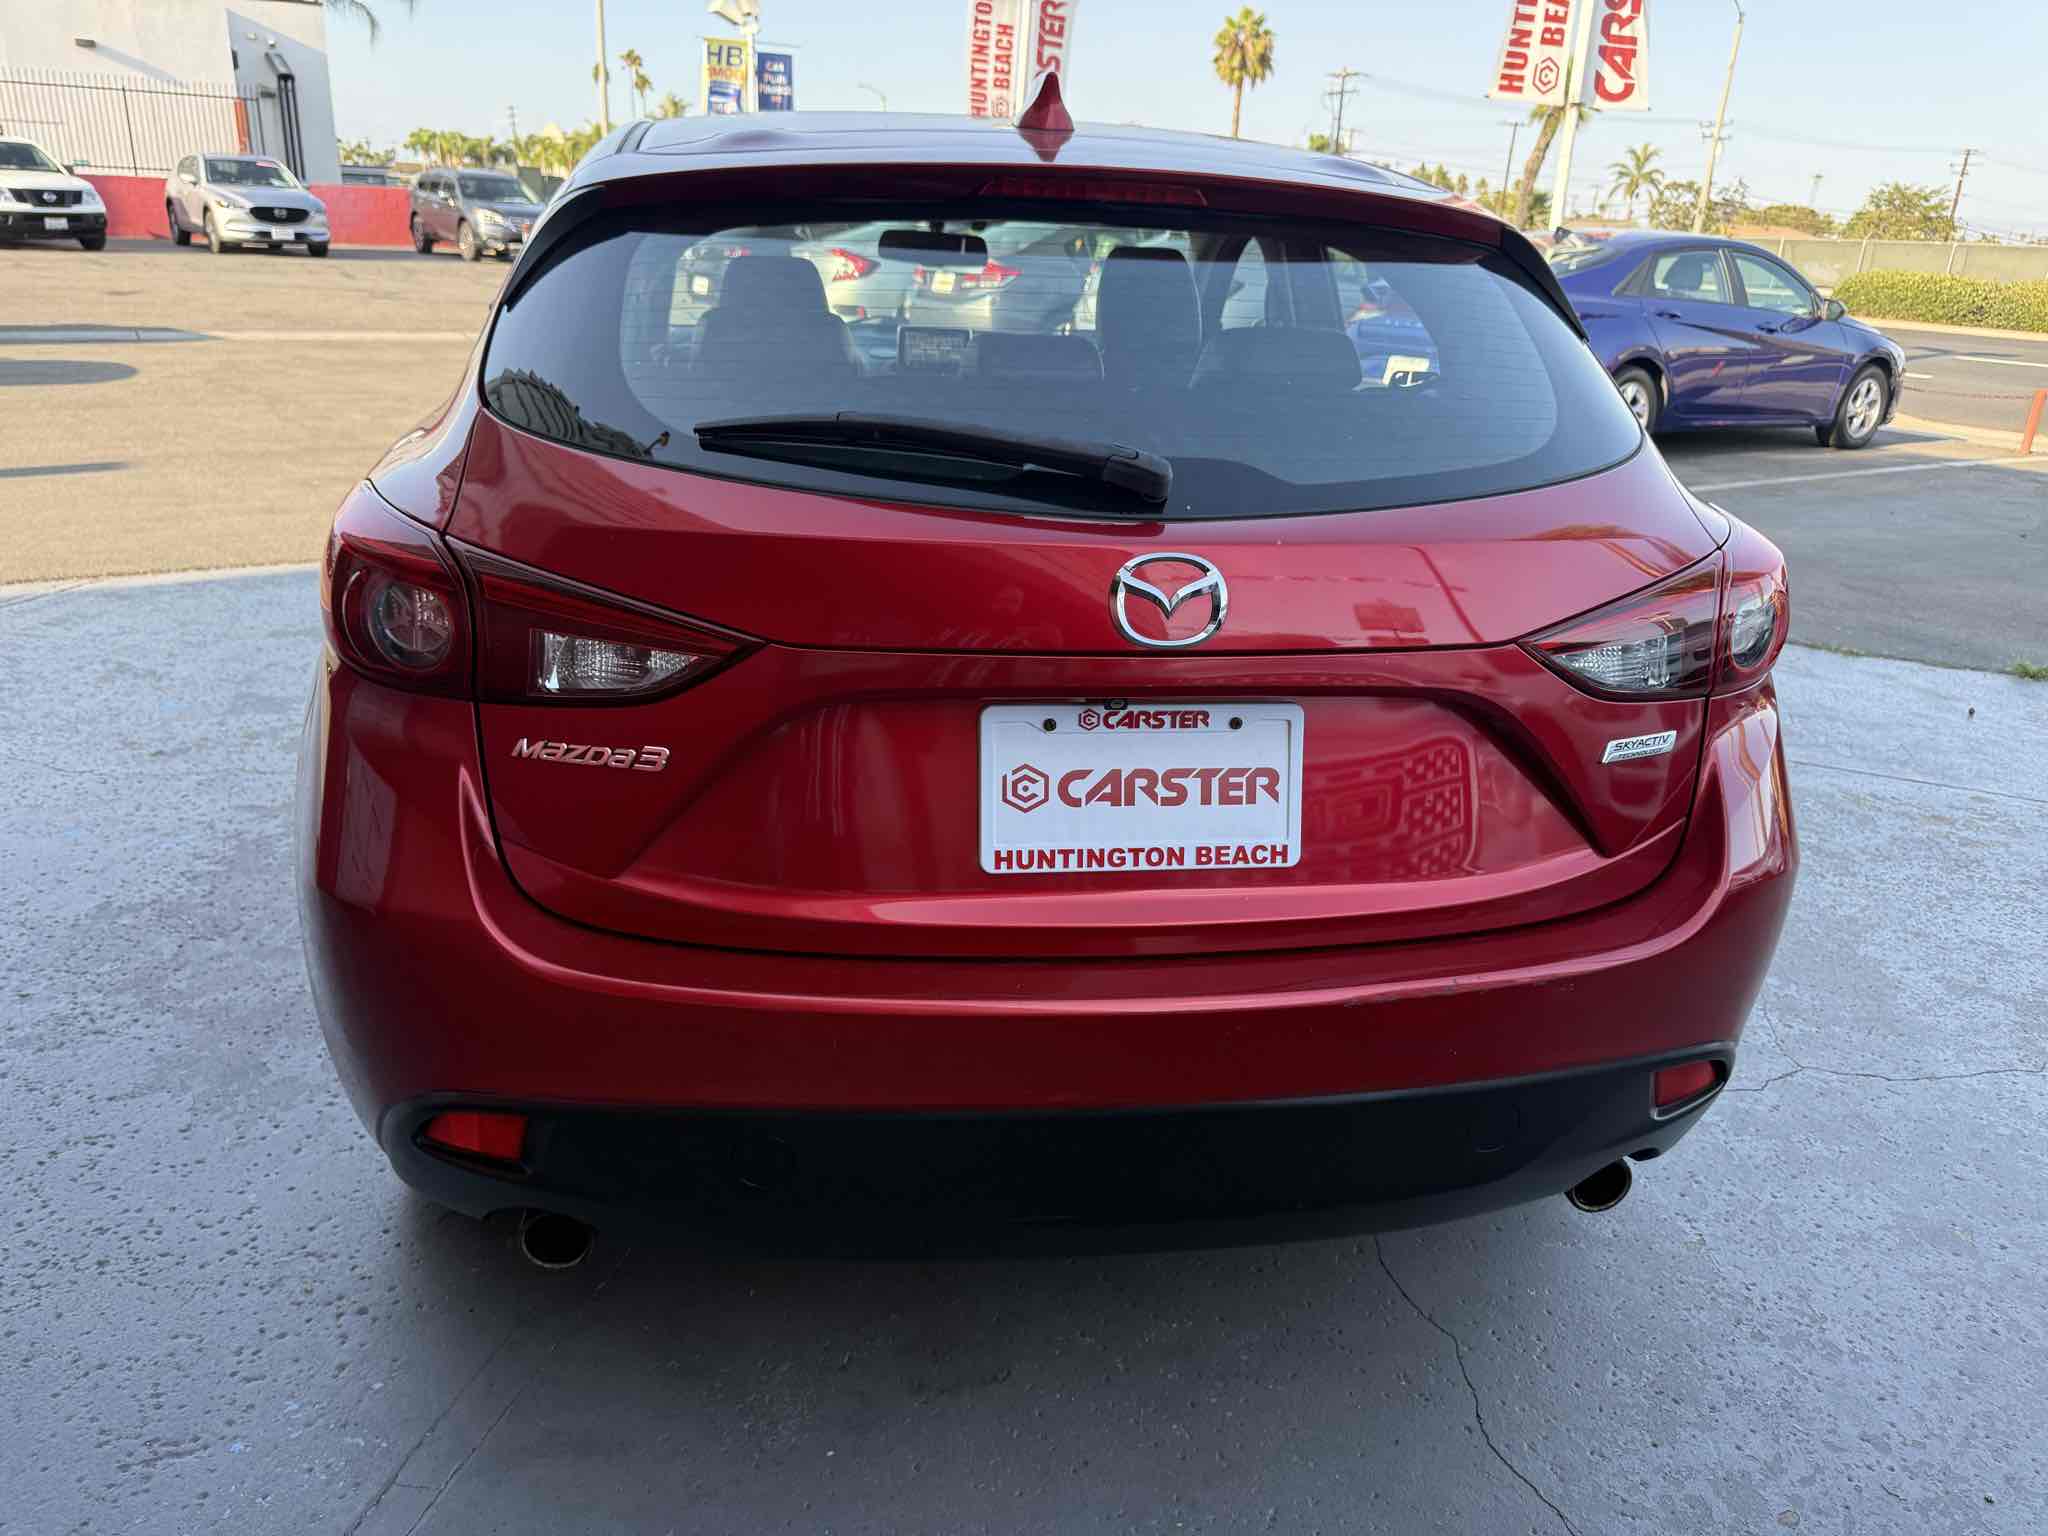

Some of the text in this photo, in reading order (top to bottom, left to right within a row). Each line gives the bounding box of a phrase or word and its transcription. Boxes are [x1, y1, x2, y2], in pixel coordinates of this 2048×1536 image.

[707, 44, 743, 66] HB
[1034, 0, 1070, 77] STER
[970, 0, 993, 118] HUNTINGTO
[993, 23, 1014, 90] BEACH
[1103, 710, 1210, 730] CARSTER
[1614, 735, 1672, 752] SKYACTIV
[1057, 767, 1280, 808] CARSTER
[994, 844, 1289, 870] HUNTINGTON BEACH
